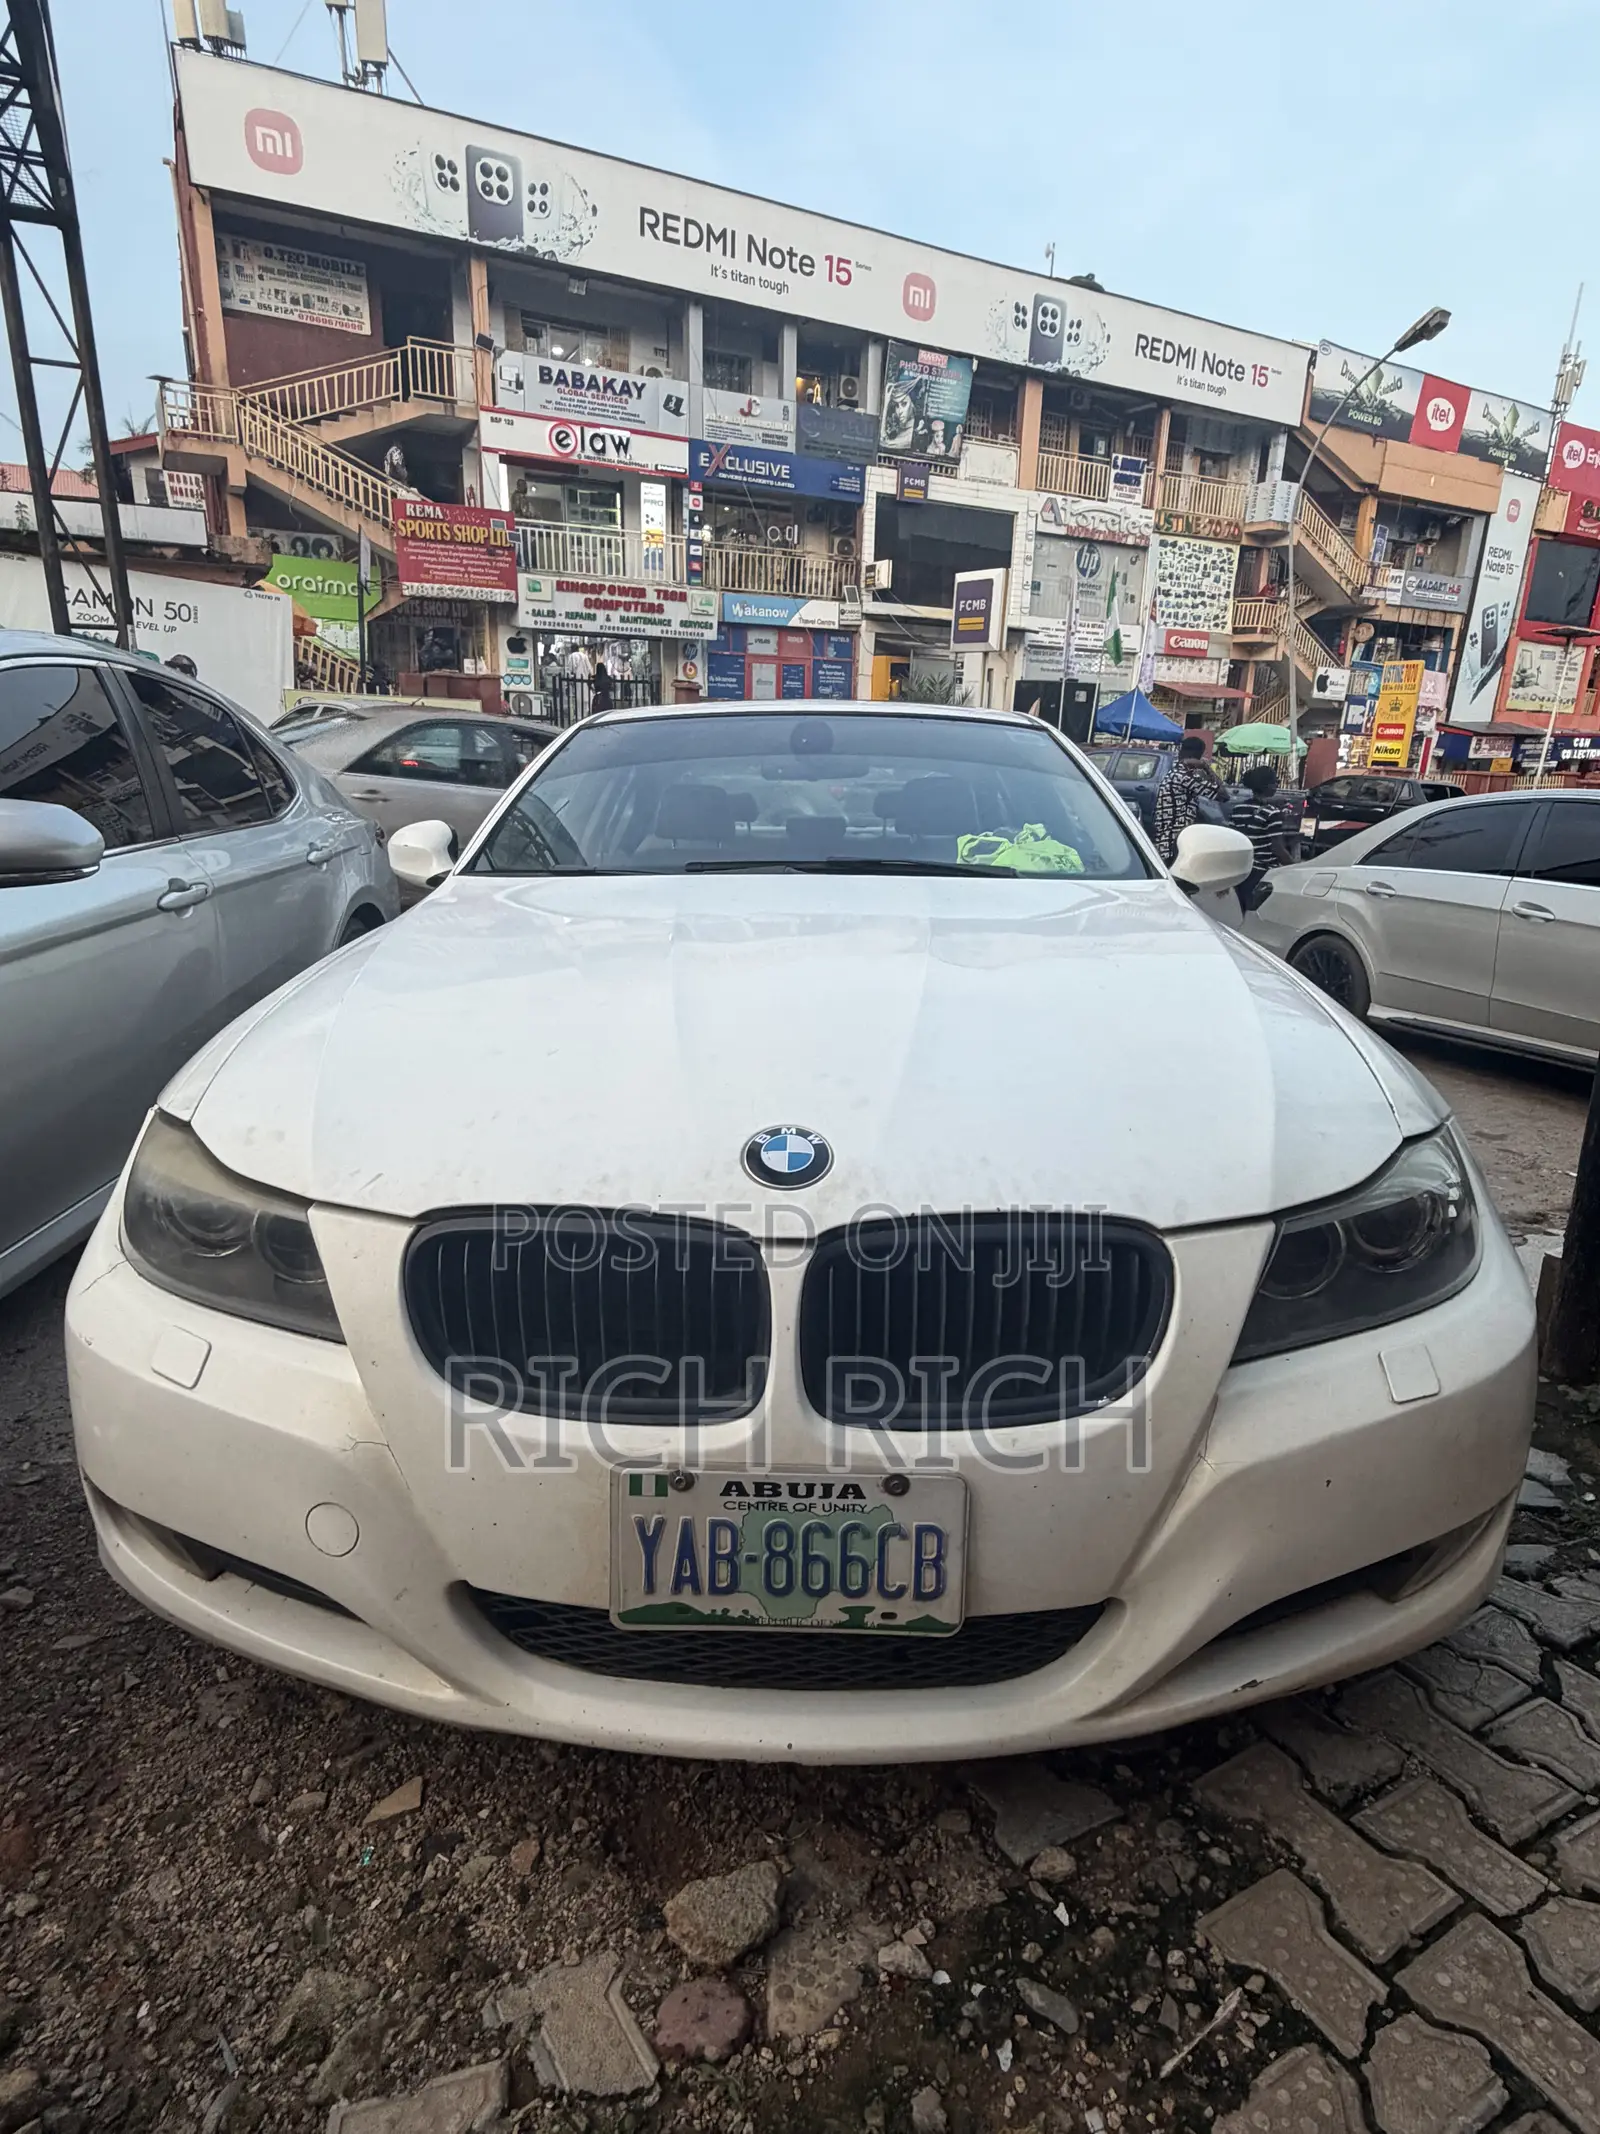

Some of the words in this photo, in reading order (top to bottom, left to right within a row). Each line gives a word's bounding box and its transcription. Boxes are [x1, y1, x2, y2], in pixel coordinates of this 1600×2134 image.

[640, 206, 736, 259] REDMI
[747, 233, 815, 277] Note
[824, 254, 852, 286] 15
[307, 252, 366, 277] MOBILE
[711, 263, 728, 280] It's
[730, 269, 755, 286] titan
[759, 278, 789, 295] tough
[899, 360, 929, 373] PHOTO
[1135, 333, 1197, 371] REDMI
[1201, 350, 1245, 382] Note
[1251, 364, 1269, 388] 15
[538, 365, 647, 400] BABAKAY
[1177, 374, 1188, 387] It's
[1189, 378, 1206, 391] titan
[1207, 382, 1227, 397] tough
[557, 387, 589, 399] GLOBAL
[591, 392, 630, 405] SERVICES
[1348, 409, 1372, 423] POWER
[1373, 417, 1382, 426] 80
[1431, 404, 1451, 424] itel
[555, 426, 631, 458] elaw
[700, 443, 790, 479] EXCLUSIVE
[1488, 447, 1508, 459] POWER
[1566, 445, 1582, 462] itel
[904, 477, 925, 487] FCMB
[397, 519, 451, 540] SPORTS
[453, 523, 489, 544] SHOP
[1079, 544, 1099, 579] hp
[1488, 546, 1512, 560] REDMI
[1486, 559, 1505, 573] Note
[1506, 563, 1515, 575] 15
[164, 601, 192, 623] 50
[584, 597, 665, 614] COMPUTERS
[732, 602, 789, 618] Wakanow
[959, 599, 986, 611] FCMB
[76, 612, 110, 625] ZOOM
[136, 621, 160, 632] EVEL
[163, 623, 178, 633] UP
[532, 608, 556, 618] SALES
[565, 611, 597, 621] REPAIRS
[605, 614, 611, 622] &
[619, 616, 672, 627] MAINTENANCE
[679, 620, 713, 630] SERVICES
[1170, 636, 1208, 649] Canon
[1377, 727, 1404, 735] Canon
[1374, 744, 1400, 755] Nikon
[755, 1127, 824, 1145] BMW
[719, 1480, 867, 1500] ABUJA
[722, 1500, 788, 1512] CENTRE
[792, 1501, 818, 1513] OF
[821, 1501, 868, 1514] UNITY
[631, 1513, 948, 1601] YAB-866CB
